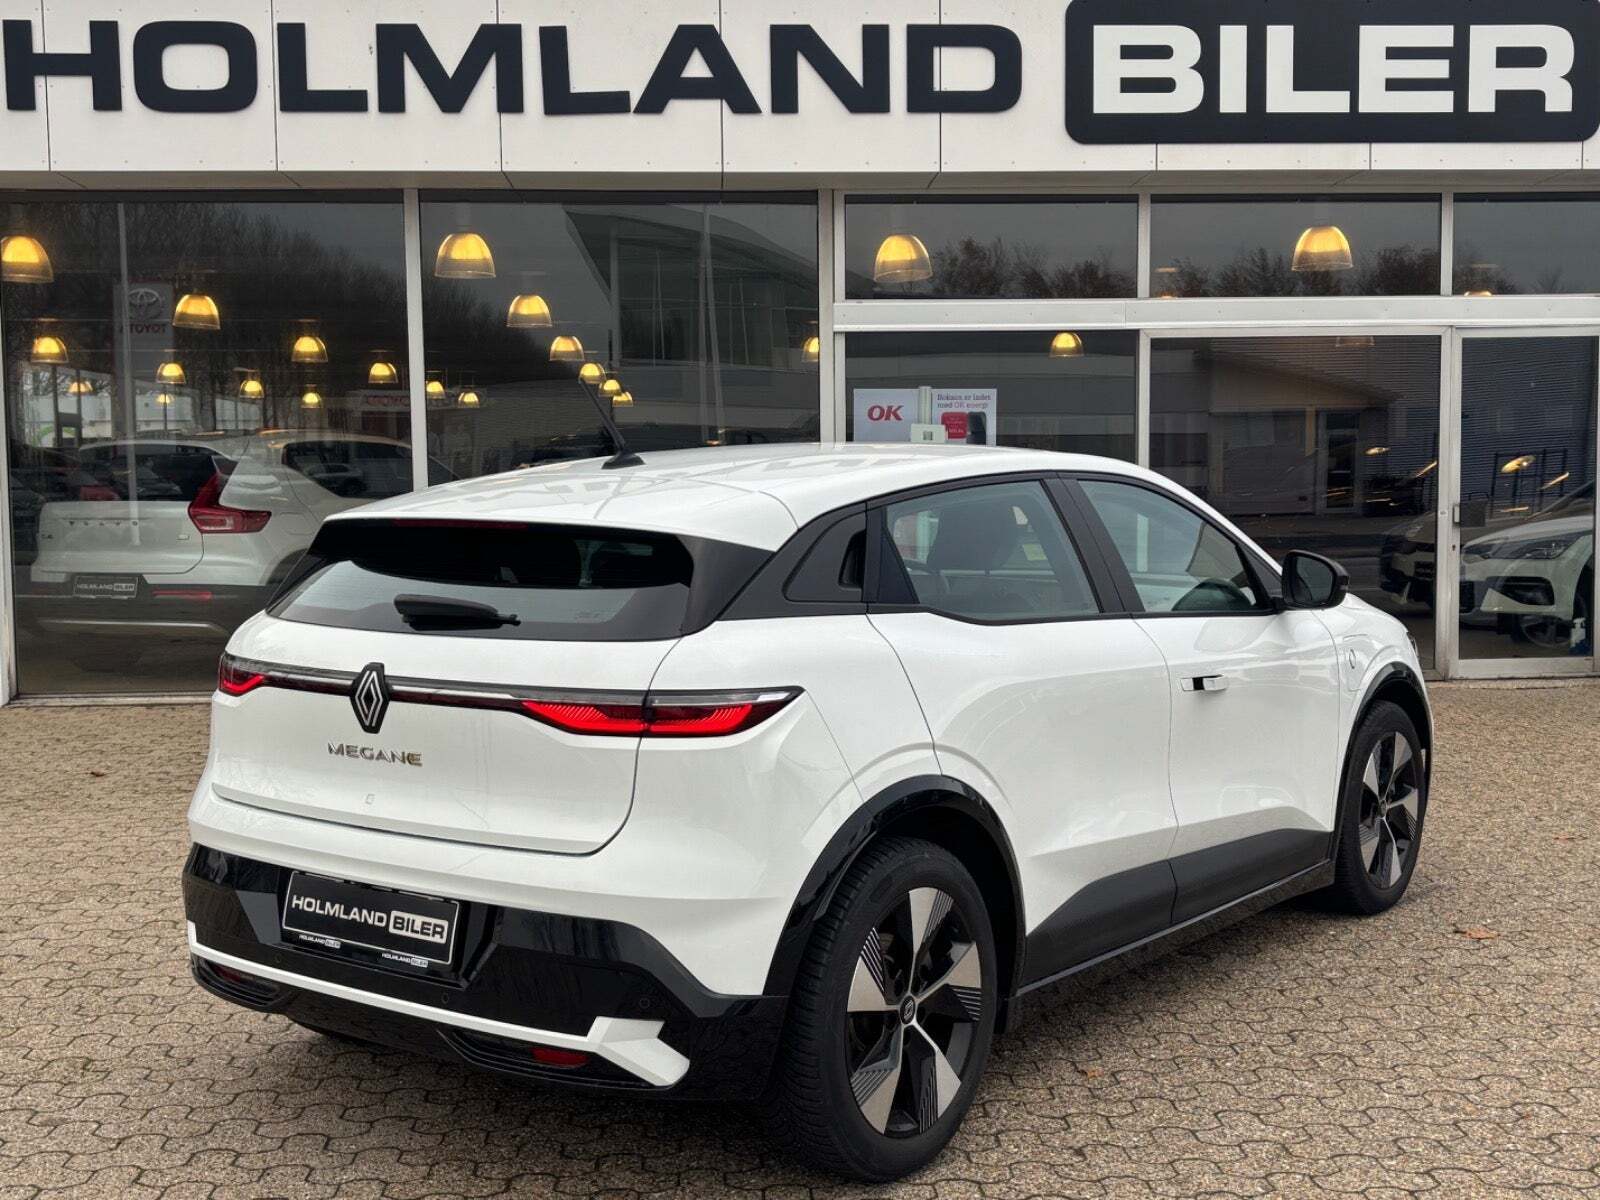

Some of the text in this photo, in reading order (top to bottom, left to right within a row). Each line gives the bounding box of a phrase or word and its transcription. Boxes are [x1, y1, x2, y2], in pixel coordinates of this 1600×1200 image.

[3, 19, 1575, 116] HOLMLAND BILER
[867, 404, 905, 421] OK
[327, 741, 424, 768] MEGANE
[291, 894, 445, 940] HOLMLAND BILER
